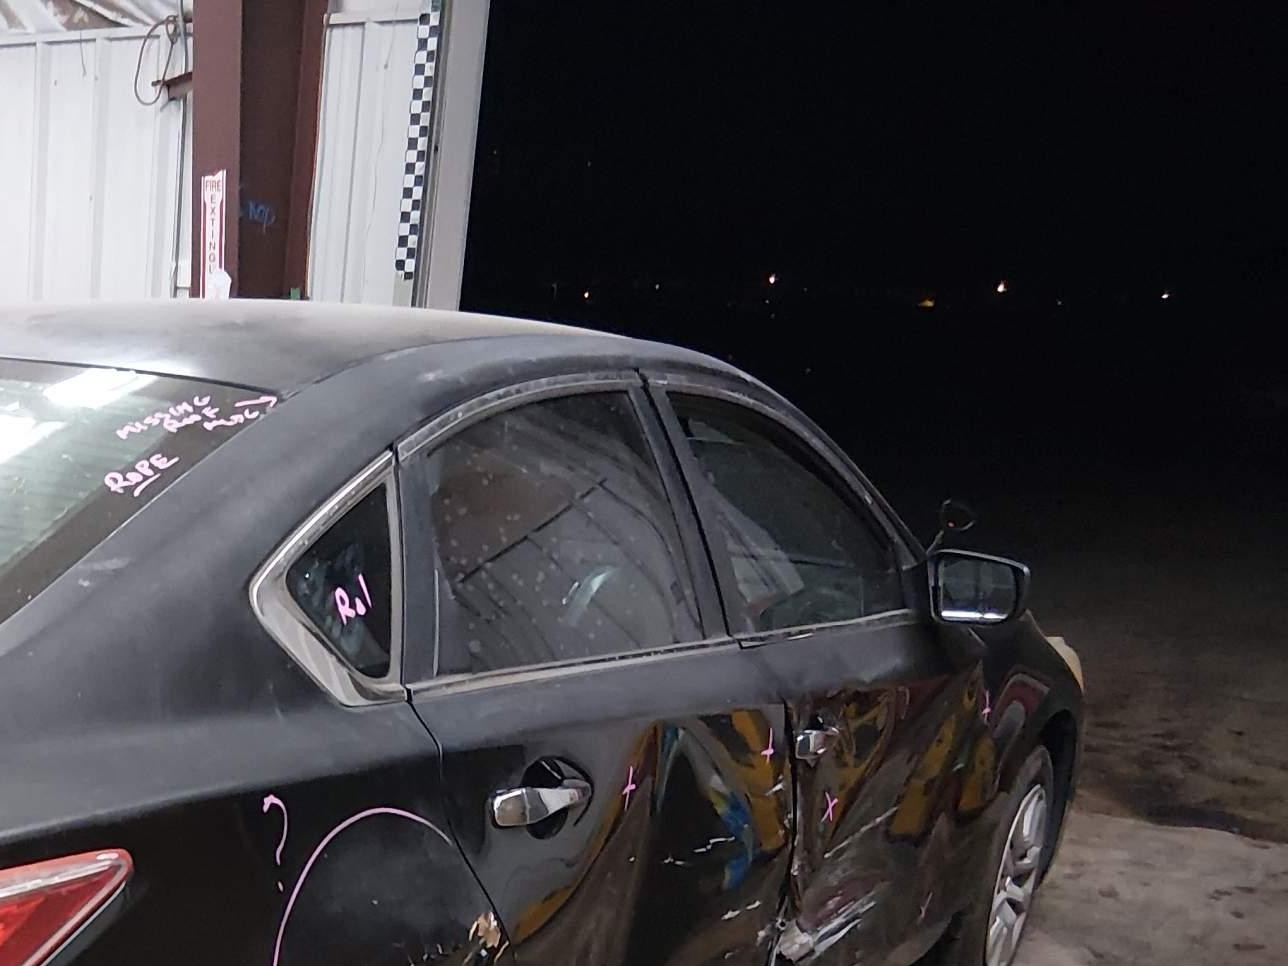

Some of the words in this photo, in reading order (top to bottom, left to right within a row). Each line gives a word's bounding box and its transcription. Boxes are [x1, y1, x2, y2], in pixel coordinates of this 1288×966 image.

[205, 180, 222, 193] FIRE
[116, 395, 211, 440] MISSING
[104, 453, 180, 494] ROPE
